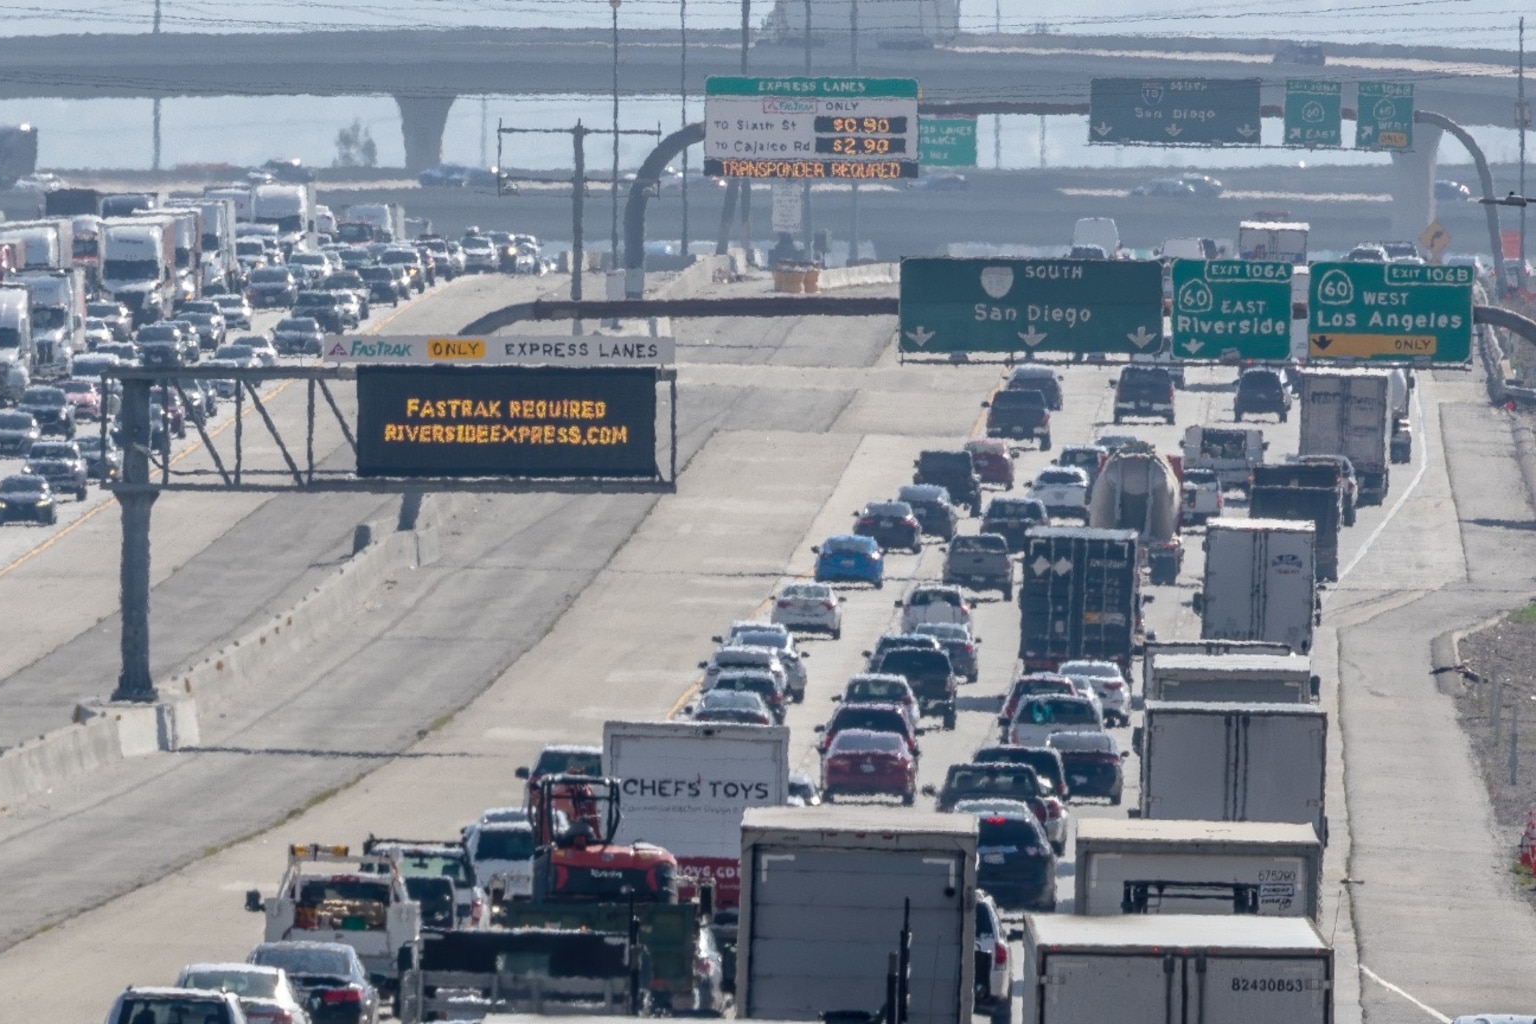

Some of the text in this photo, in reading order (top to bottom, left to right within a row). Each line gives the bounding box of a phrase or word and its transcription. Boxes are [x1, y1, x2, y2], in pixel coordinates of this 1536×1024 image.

[758, 81, 866, 92] EXPRESS LANES
[825, 102, 859, 112] ONLY
[1135, 108, 1216, 121] San Diego
[737, 119, 775, 131] Sixth
[833, 118, 890, 133] $0.90
[734, 140, 788, 153] Cajalco
[793, 141, 811, 151] Rd
[833, 138, 890, 154] $2.90
[721, 160, 901, 178] TRANSPONDER REQUIRED
[1025, 265, 1083, 279] SOUTH
[1211, 264, 1288, 278] EXIT 106A
[1392, 268, 1468, 282] EXIT 106B
[1325, 279, 1347, 297] 60
[1183, 290, 1208, 306] 60
[1363, 291, 1409, 306] WEST
[1221, 301, 1265, 314] EAST
[974, 303, 1092, 328] San Diego
[1317, 311, 1462, 330] Los Angeles
[1177, 315, 1286, 335] Riverside
[432, 343, 480, 356] ONLY
[505, 343, 589, 357] EXPRESS
[599, 344, 659, 358] LANES
[1394, 338, 1432, 350] ONLY
[509, 398, 607, 419] REQUIRED
[384, 424, 628, 446] RIVERSIDEEXPRESS.COM
[709, 781, 769, 799] TOYS
